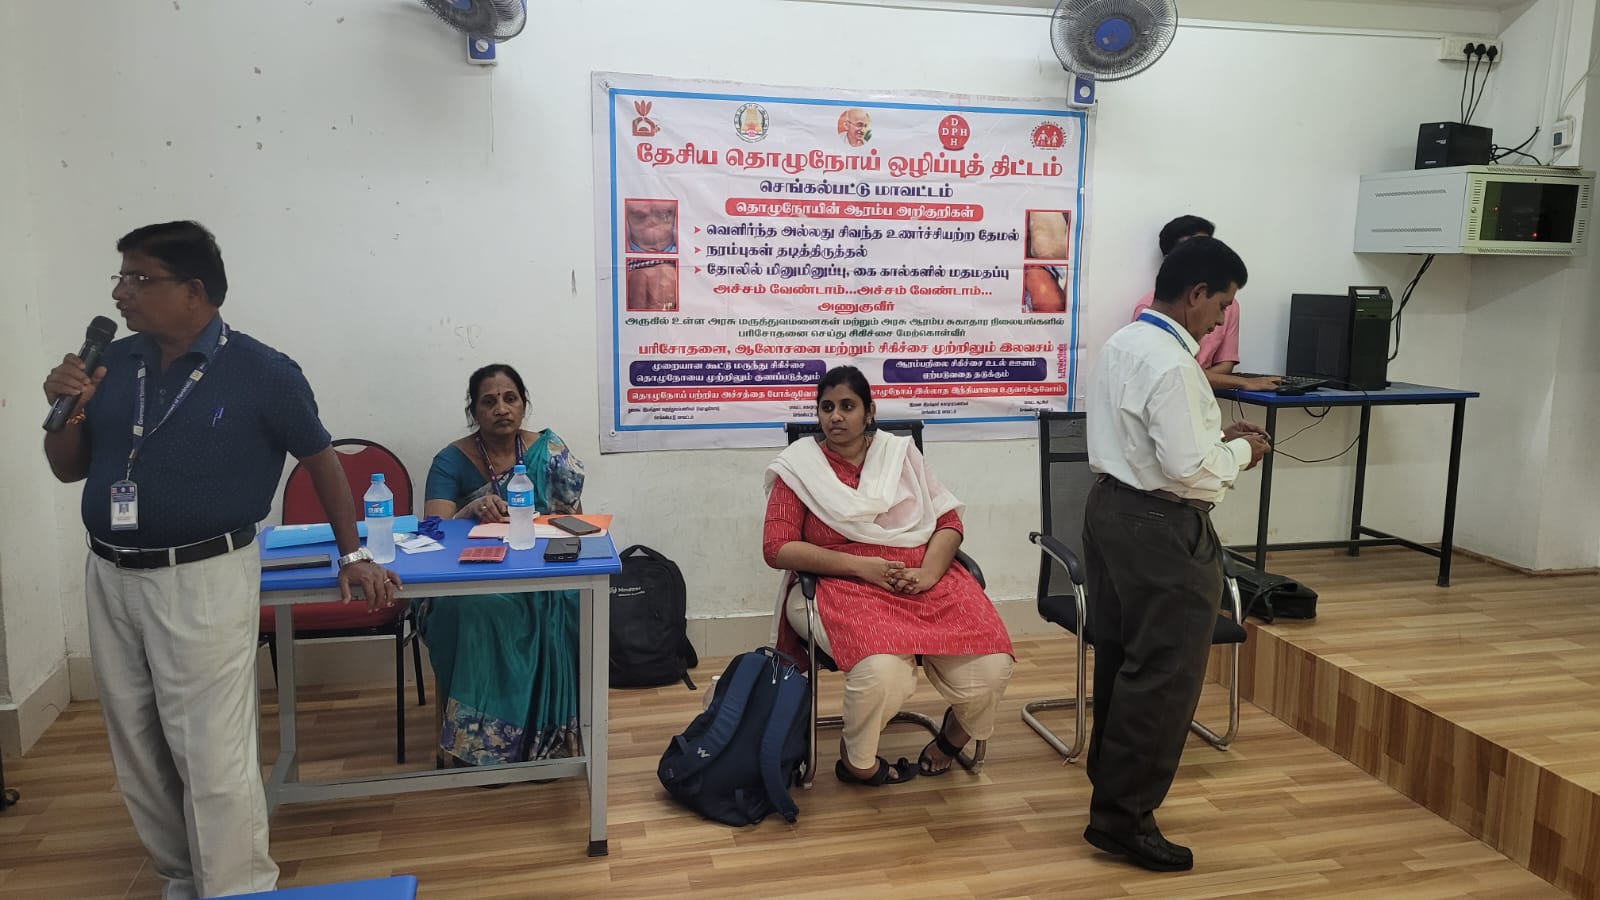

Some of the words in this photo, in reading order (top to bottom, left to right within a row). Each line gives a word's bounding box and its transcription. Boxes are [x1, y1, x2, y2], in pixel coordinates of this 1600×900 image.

[636, 142, 718, 168] தேசிய
[725, 148, 881, 174] தொழுநோய்
[887, 151, 986, 178] ஒழிப்புத்
[990, 154, 1063, 179] திட்டம்
[759, 178, 871, 198] செங்கல்பட்டு
[875, 182, 954, 198] மாவட்டம்
[736, 201, 841, 218] தொழுநோயின்
[844, 203, 893, 216] ஆரம்ப
[896, 204, 975, 220] அறிகுறிகள்
[706, 223, 778, 240] வெளிர்ந்த
[781, 224, 835, 240] அல்லது
[838, 225, 883, 240] சிவந்த
[886, 226, 975, 242] உணர்ச்சியற்ற
[978, 228, 1020, 242] தேமல்
[706, 242, 773, 258] நரம்புகள்
[776, 244, 868, 259] தடித்திருத்தல்
[707, 262, 762, 276] தோலில்
[766, 263, 850, 280] மினுமினுப்பு,
[853, 266, 876, 277] கை
[880, 264, 946, 278] கால்களில்
[949, 266, 1010, 280] மதமதப்பு
[713, 283, 766, 295] அச்சம்
[818, 300, 896, 314] அணுகுவீர்
[625, 316, 670, 326] அருகில்
[672, 317, 704, 326] உள்ள
[708, 318, 736, 326] அரசு
[738, 316, 840, 328] மருத்துவமனைகள்
[842, 316, 879, 327] மற்றும்
[881, 318, 907, 326] அரசு
[909, 318, 944, 327] ஆரம்ப
[946, 318, 988, 327] சுகாதார
[990, 317, 1065, 328] நிலையங்களில்
[738, 329, 808, 340] பரிசோதனை
[811, 329, 847, 339] செய்து
[848, 329, 893, 338] சிகிச்சை
[896, 328, 966, 338] மேற்கொள்வீர்
[638, 342, 731, 356] பரிசோதனை,
[734, 342, 822, 356] ஆலோசனை
[824, 342, 875, 357] மற்றும்
[879, 341, 928, 354] சிகிச்சை
[932, 341, 996, 356] முற்றிலும்
[1000, 340, 1054, 354] இலவசம்
